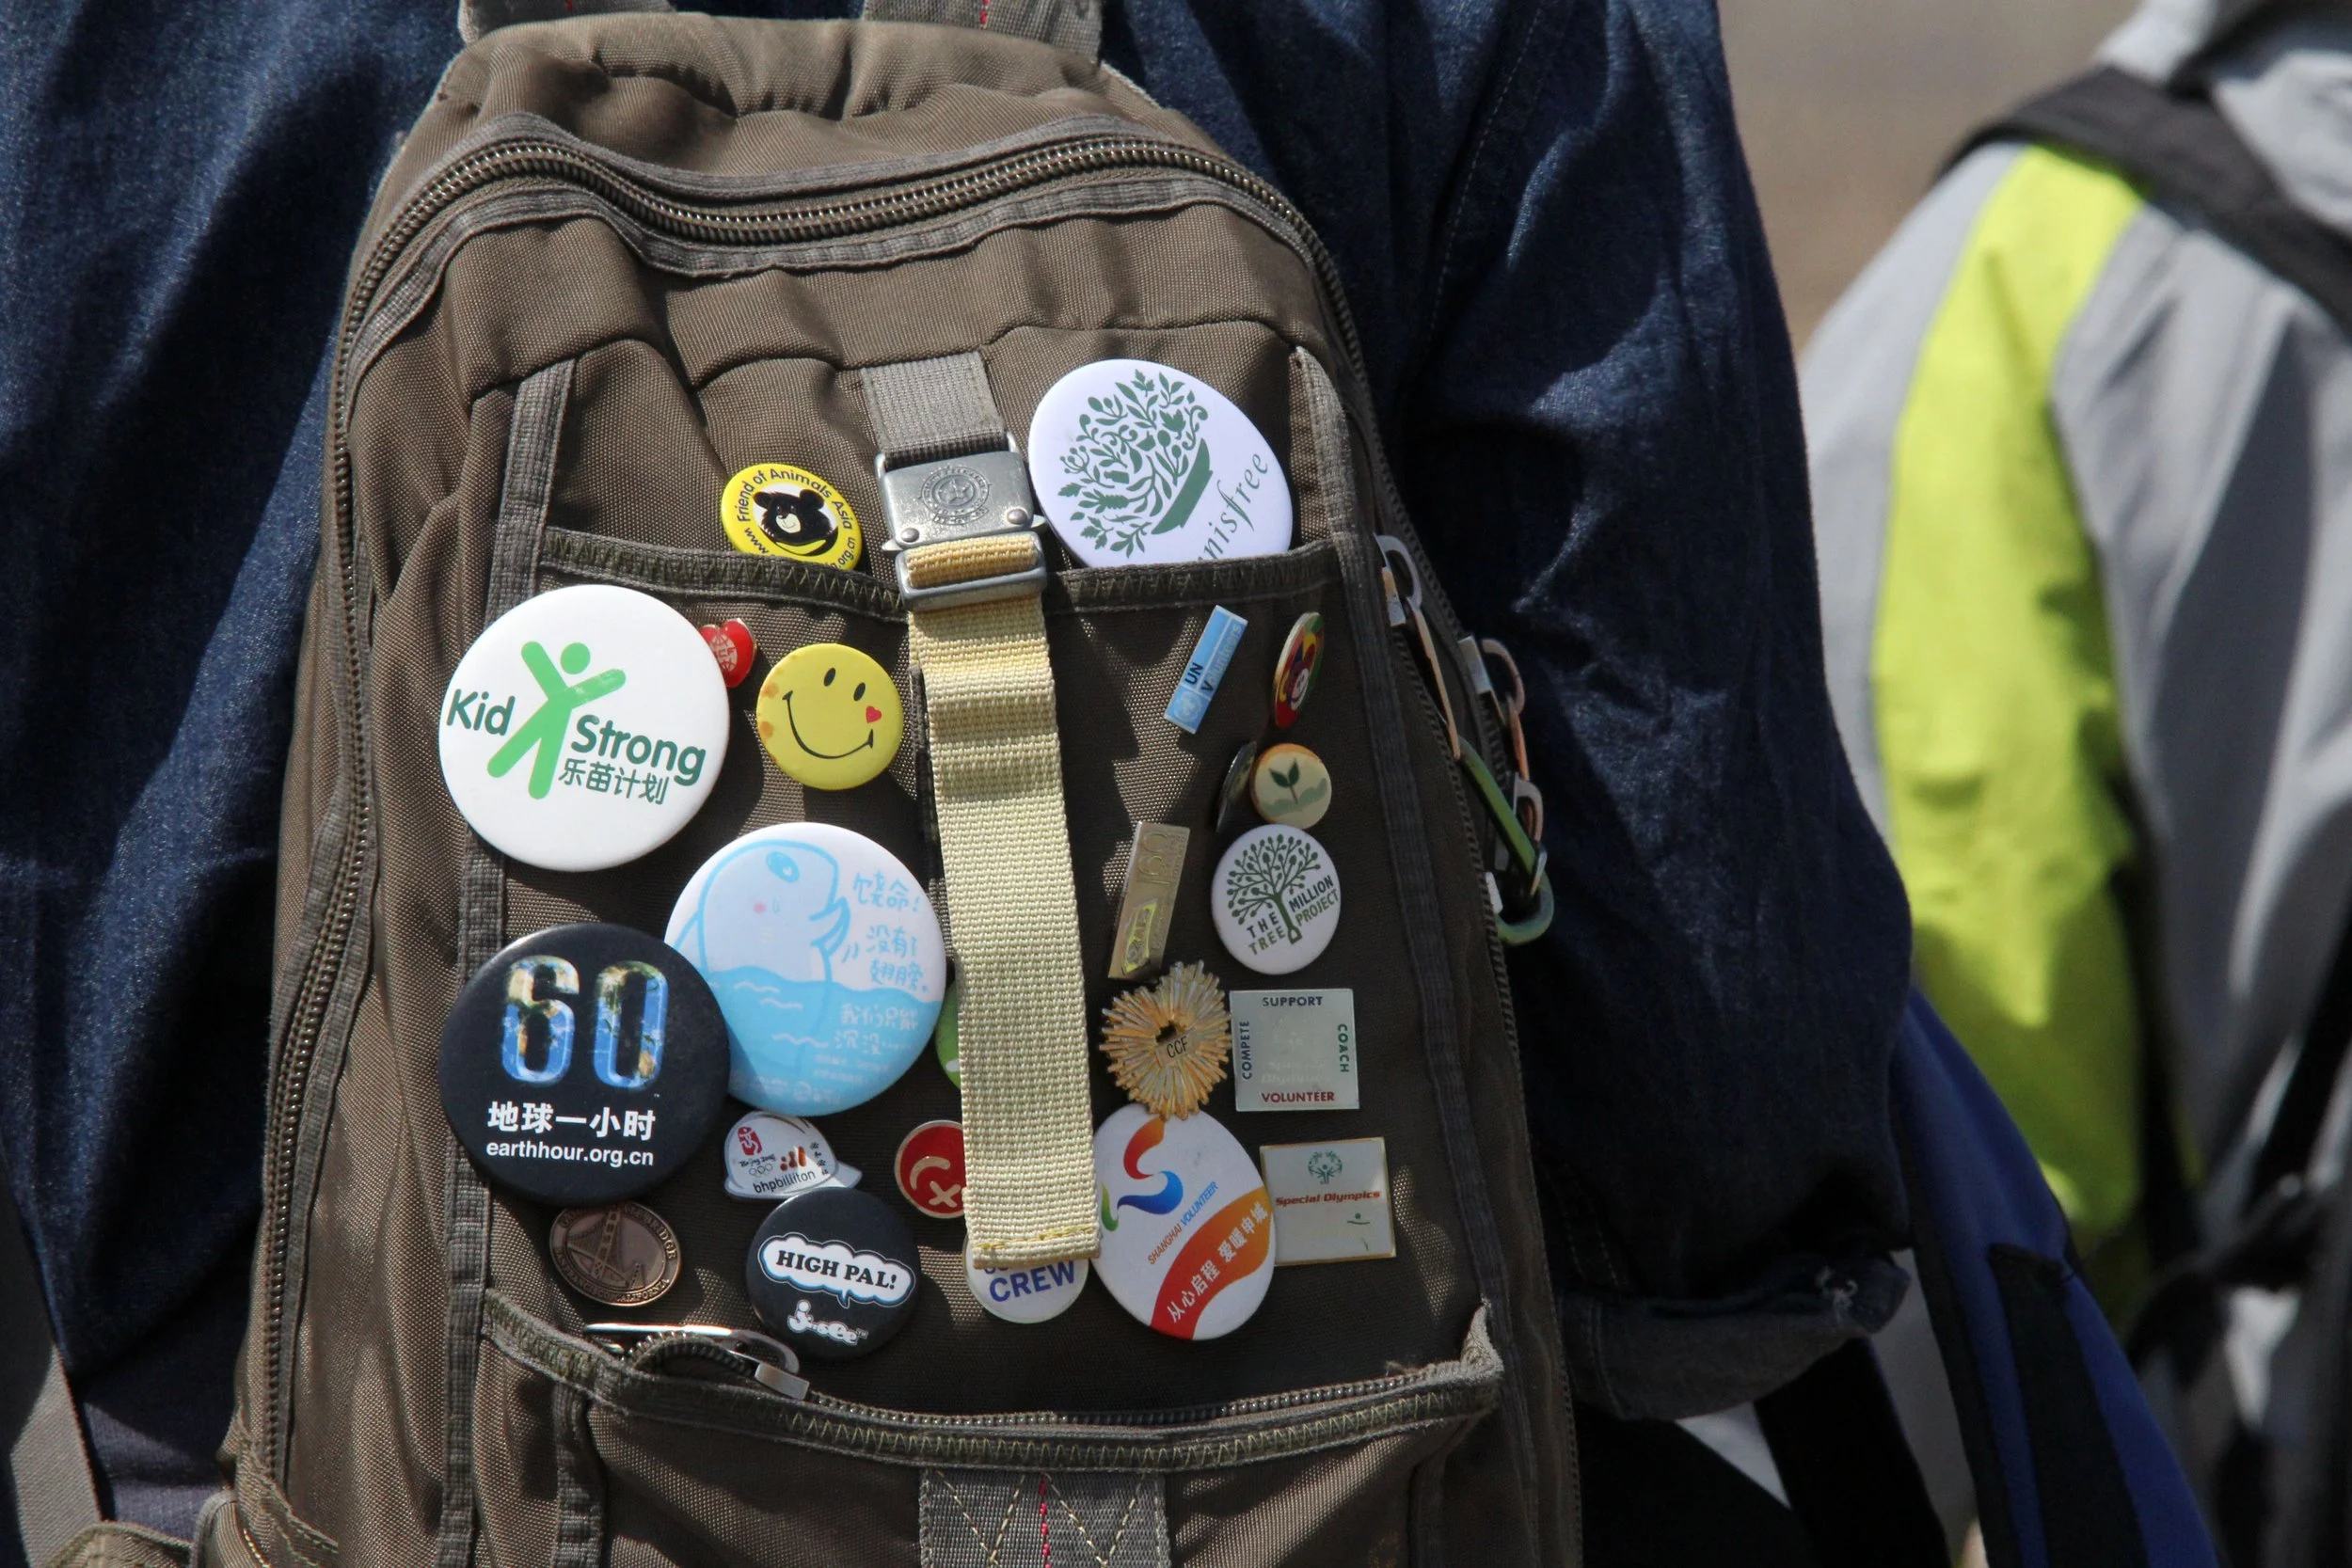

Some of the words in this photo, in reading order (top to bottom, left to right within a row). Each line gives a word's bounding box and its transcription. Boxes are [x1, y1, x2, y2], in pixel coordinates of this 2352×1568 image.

[737, 481, 755, 522] Friend
[753, 469, 768, 484] of
[770, 468, 833, 499] Animals
[832, 500, 853, 530] Asia
[1198, 453, 1268, 561] nisfree
[1184, 662, 1204, 685] UN
[446, 689, 516, 736] Kid
[570, 714, 707, 786] Strong
[558, 757, 670, 805] 乐苗计划
[1247, 911, 1279, 939] THE
[1288, 875, 1334, 912] MILLION
[1248, 926, 1285, 956] TREE
[1295, 888, 1340, 927] PROJECT
[501, 955, 669, 1088] 60
[1263, 996, 1324, 1007] SUPPORT
[1167, 1035, 1188, 1058] CCF
[1239, 1021, 1252, 1080] COMPETE
[1338, 1023, 1350, 1073] COACH
[487, 1101, 656, 1141] 地球一小时
[1261, 1091, 1335, 1103] VOLUNTEER
[485, 1140, 654, 1168] earthhour.org.cn
[753, 1169, 817, 1194] bhpbilliton
[1276, 1194, 1321, 1207] Special
[1324, 1191, 1381, 1203] Olympics
[1147, 1223, 1183, 1265] SHANGHAI
[1180, 1180, 1219, 1227] VOLUNTEER
[776, 1250, 840, 1277] HIGH
[844, 1264, 898, 1290] PAL!
[990, 1259, 1075, 1302] CREW
[1167, 1259, 1221, 1323] 从心启程
